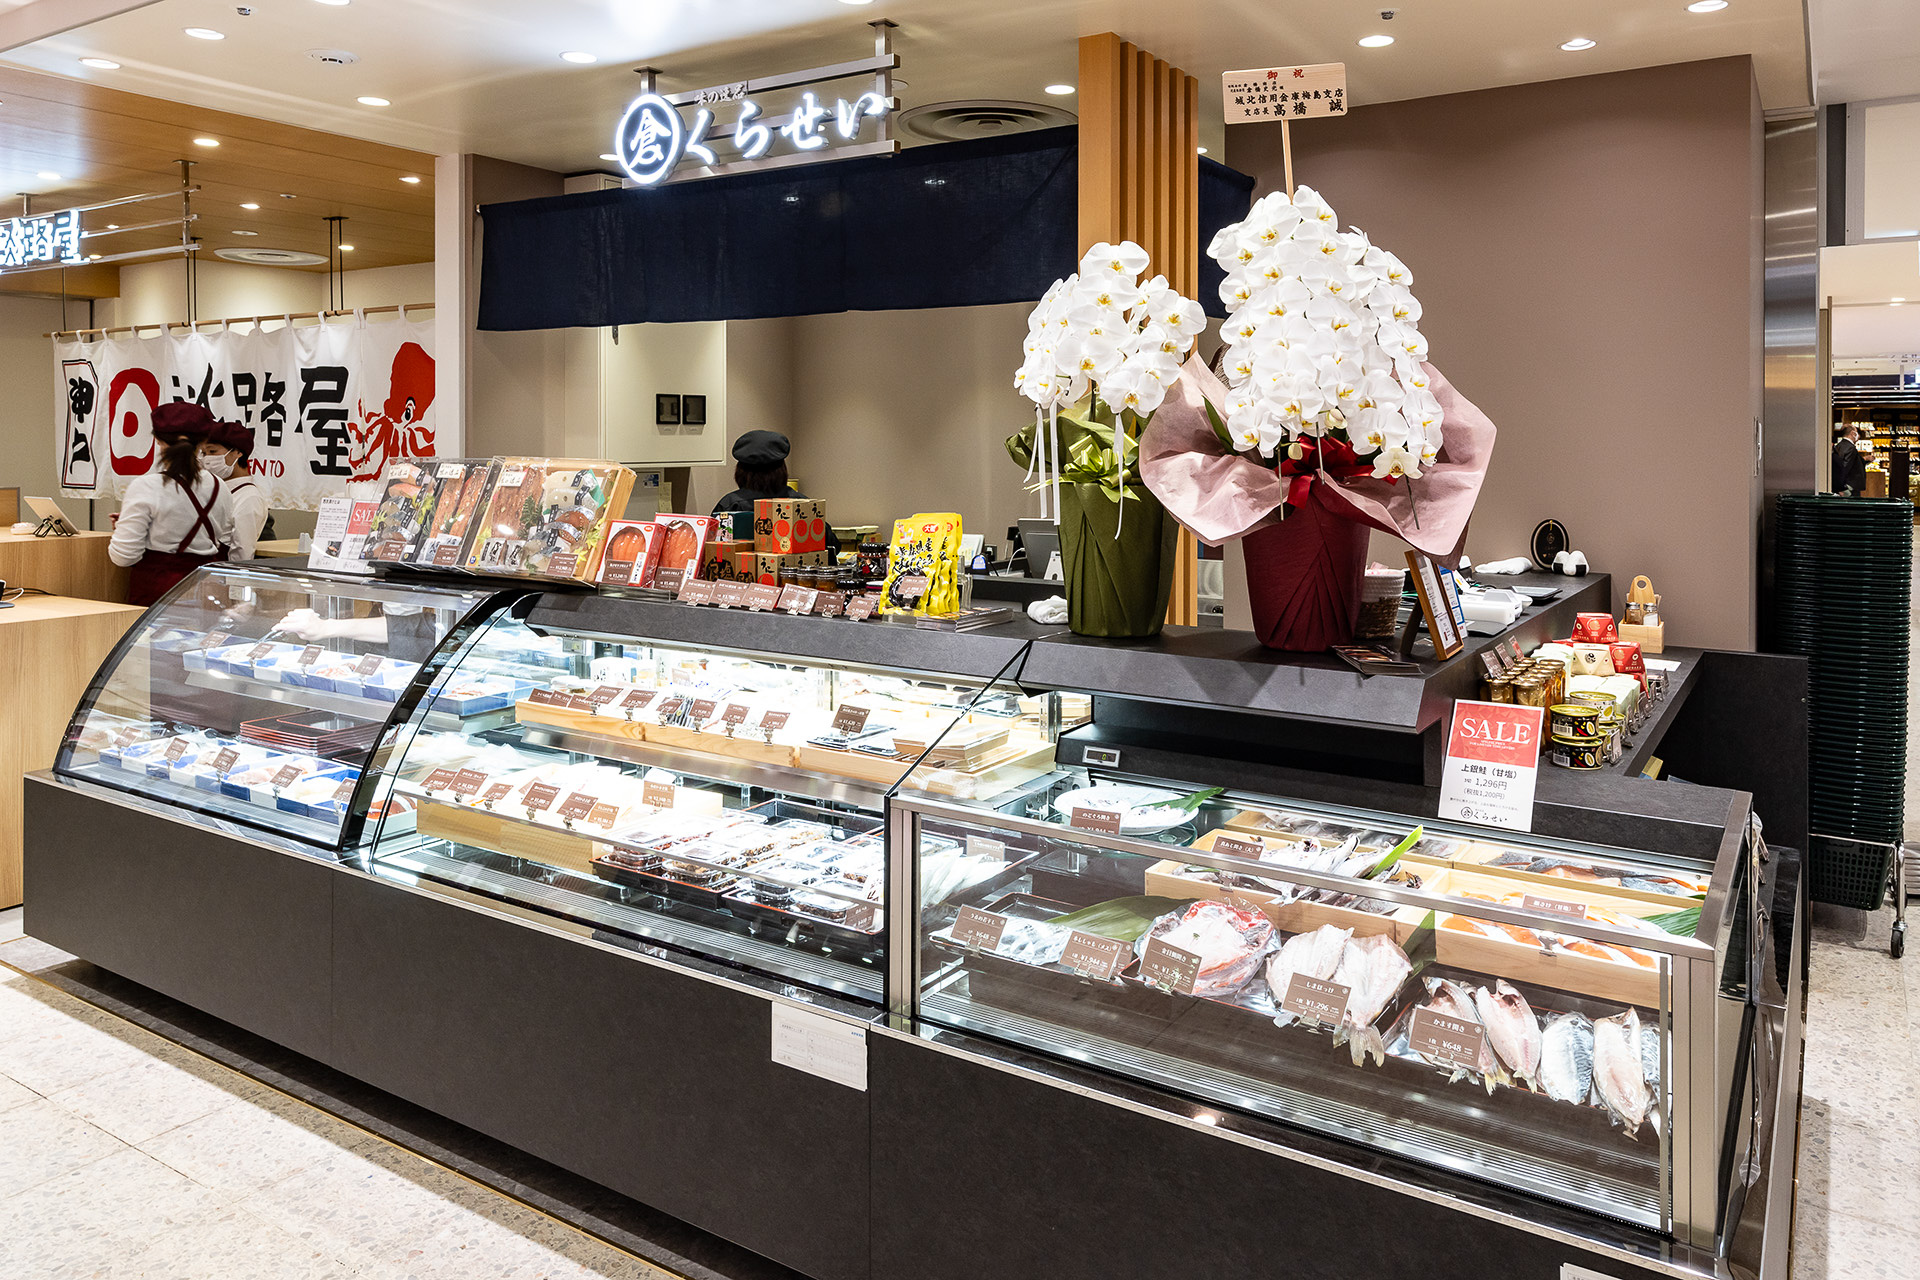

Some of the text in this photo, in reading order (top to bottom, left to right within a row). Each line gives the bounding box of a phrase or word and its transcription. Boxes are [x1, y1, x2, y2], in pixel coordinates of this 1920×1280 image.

[685, 91, 889, 166] くらせい
[353, 508, 377, 522] SAL
[776, 503, 791, 520] うに
[794, 503, 808, 520] うに
[760, 557, 775, 573] うに
[1459, 718, 1531, 745] SALE
[1306, 981, 1335, 994] しまほっけ
[1306, 999, 1330, 1012] ¥1,296
[1433, 1018, 1465, 1033] かます開き
[1442, 1040, 1462, 1053] ¥648
